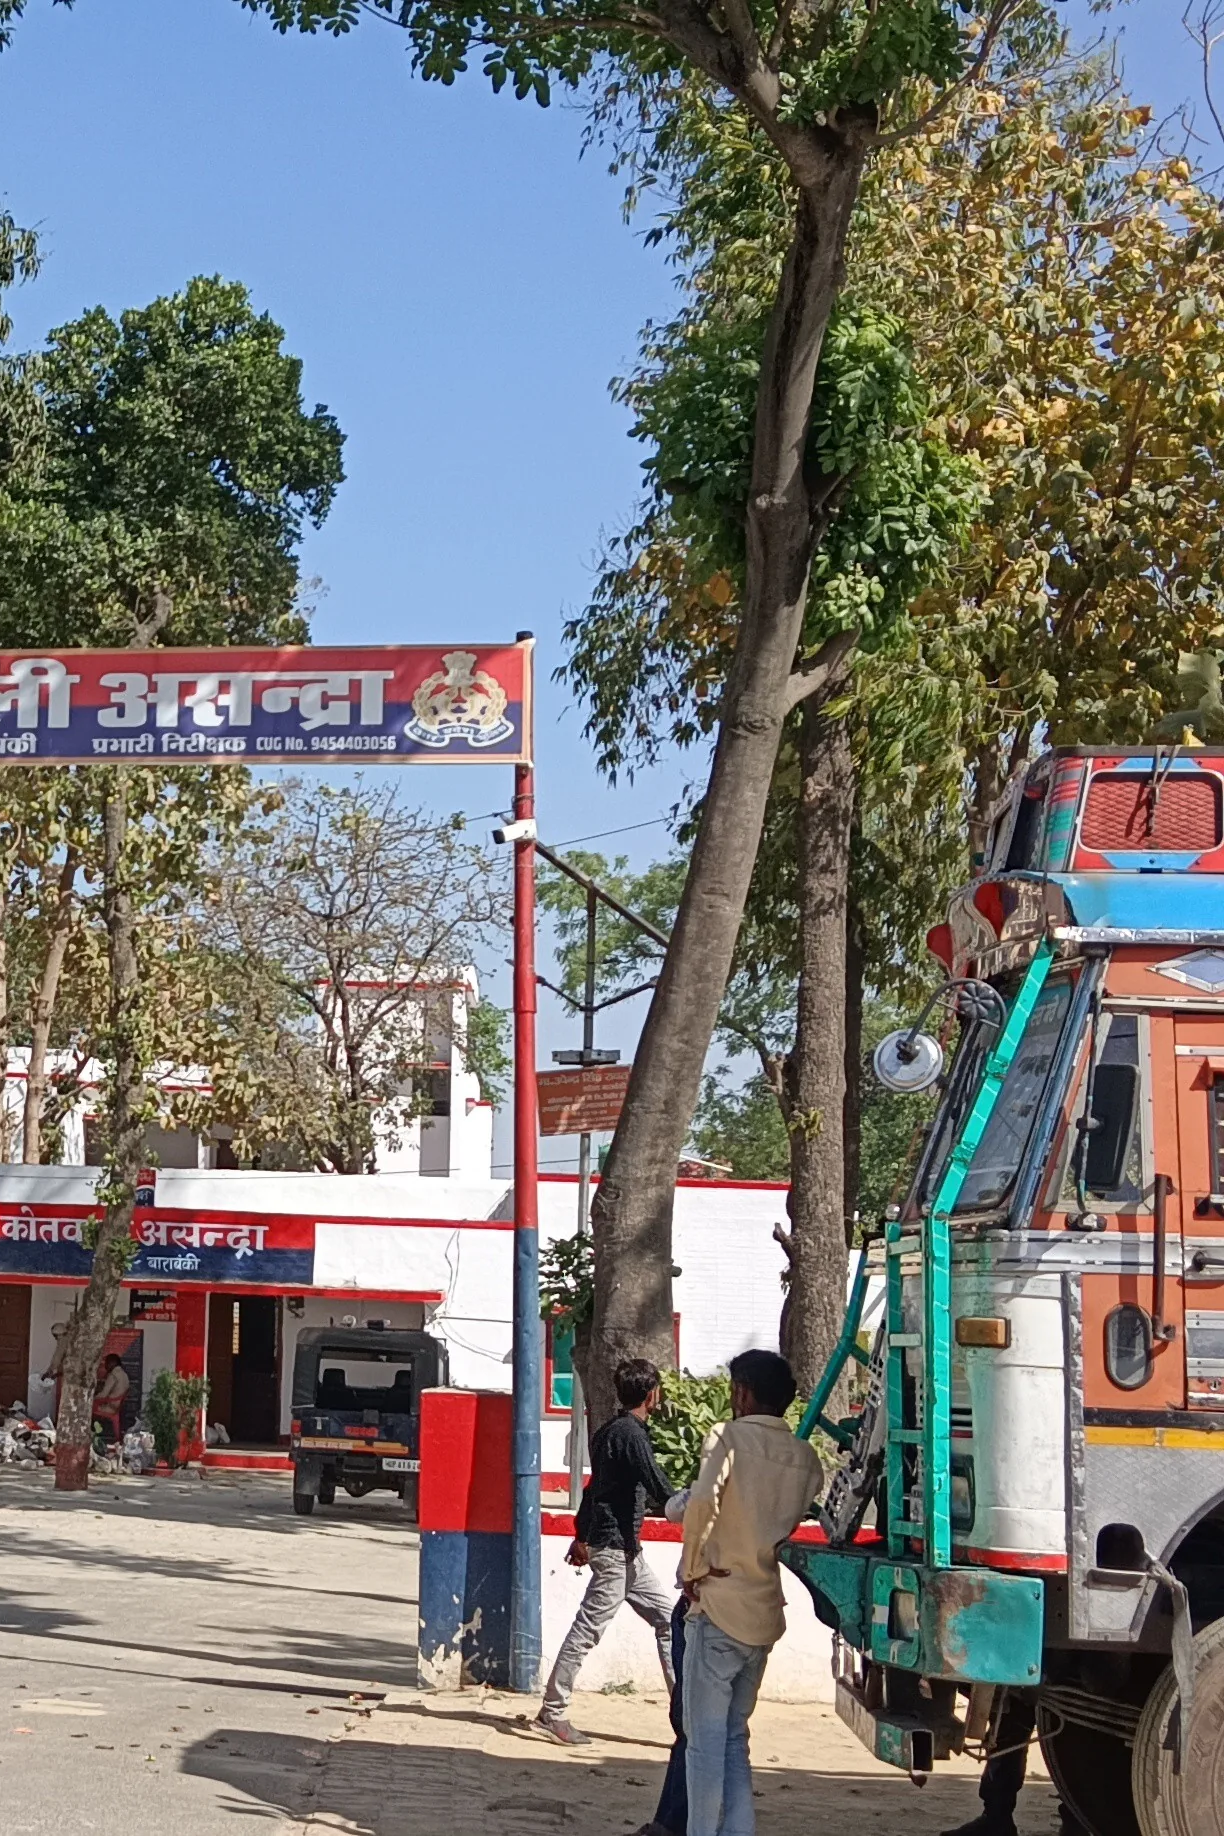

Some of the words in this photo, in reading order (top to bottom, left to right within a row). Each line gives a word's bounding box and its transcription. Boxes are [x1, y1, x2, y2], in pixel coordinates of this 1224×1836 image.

[97, 670, 394, 731] असन्द्रा
[91, 733, 155, 754] प्रभारी
[161, 732, 247, 753] निरीक्षक
[256, 737, 282, 750] CUG
[285, 737, 307, 750] No.
[311, 736, 396, 750] 9454403056
[136, 1219, 269, 1260] असन्द्रा
[147, 1255, 201, 1273] बाराबंकी
